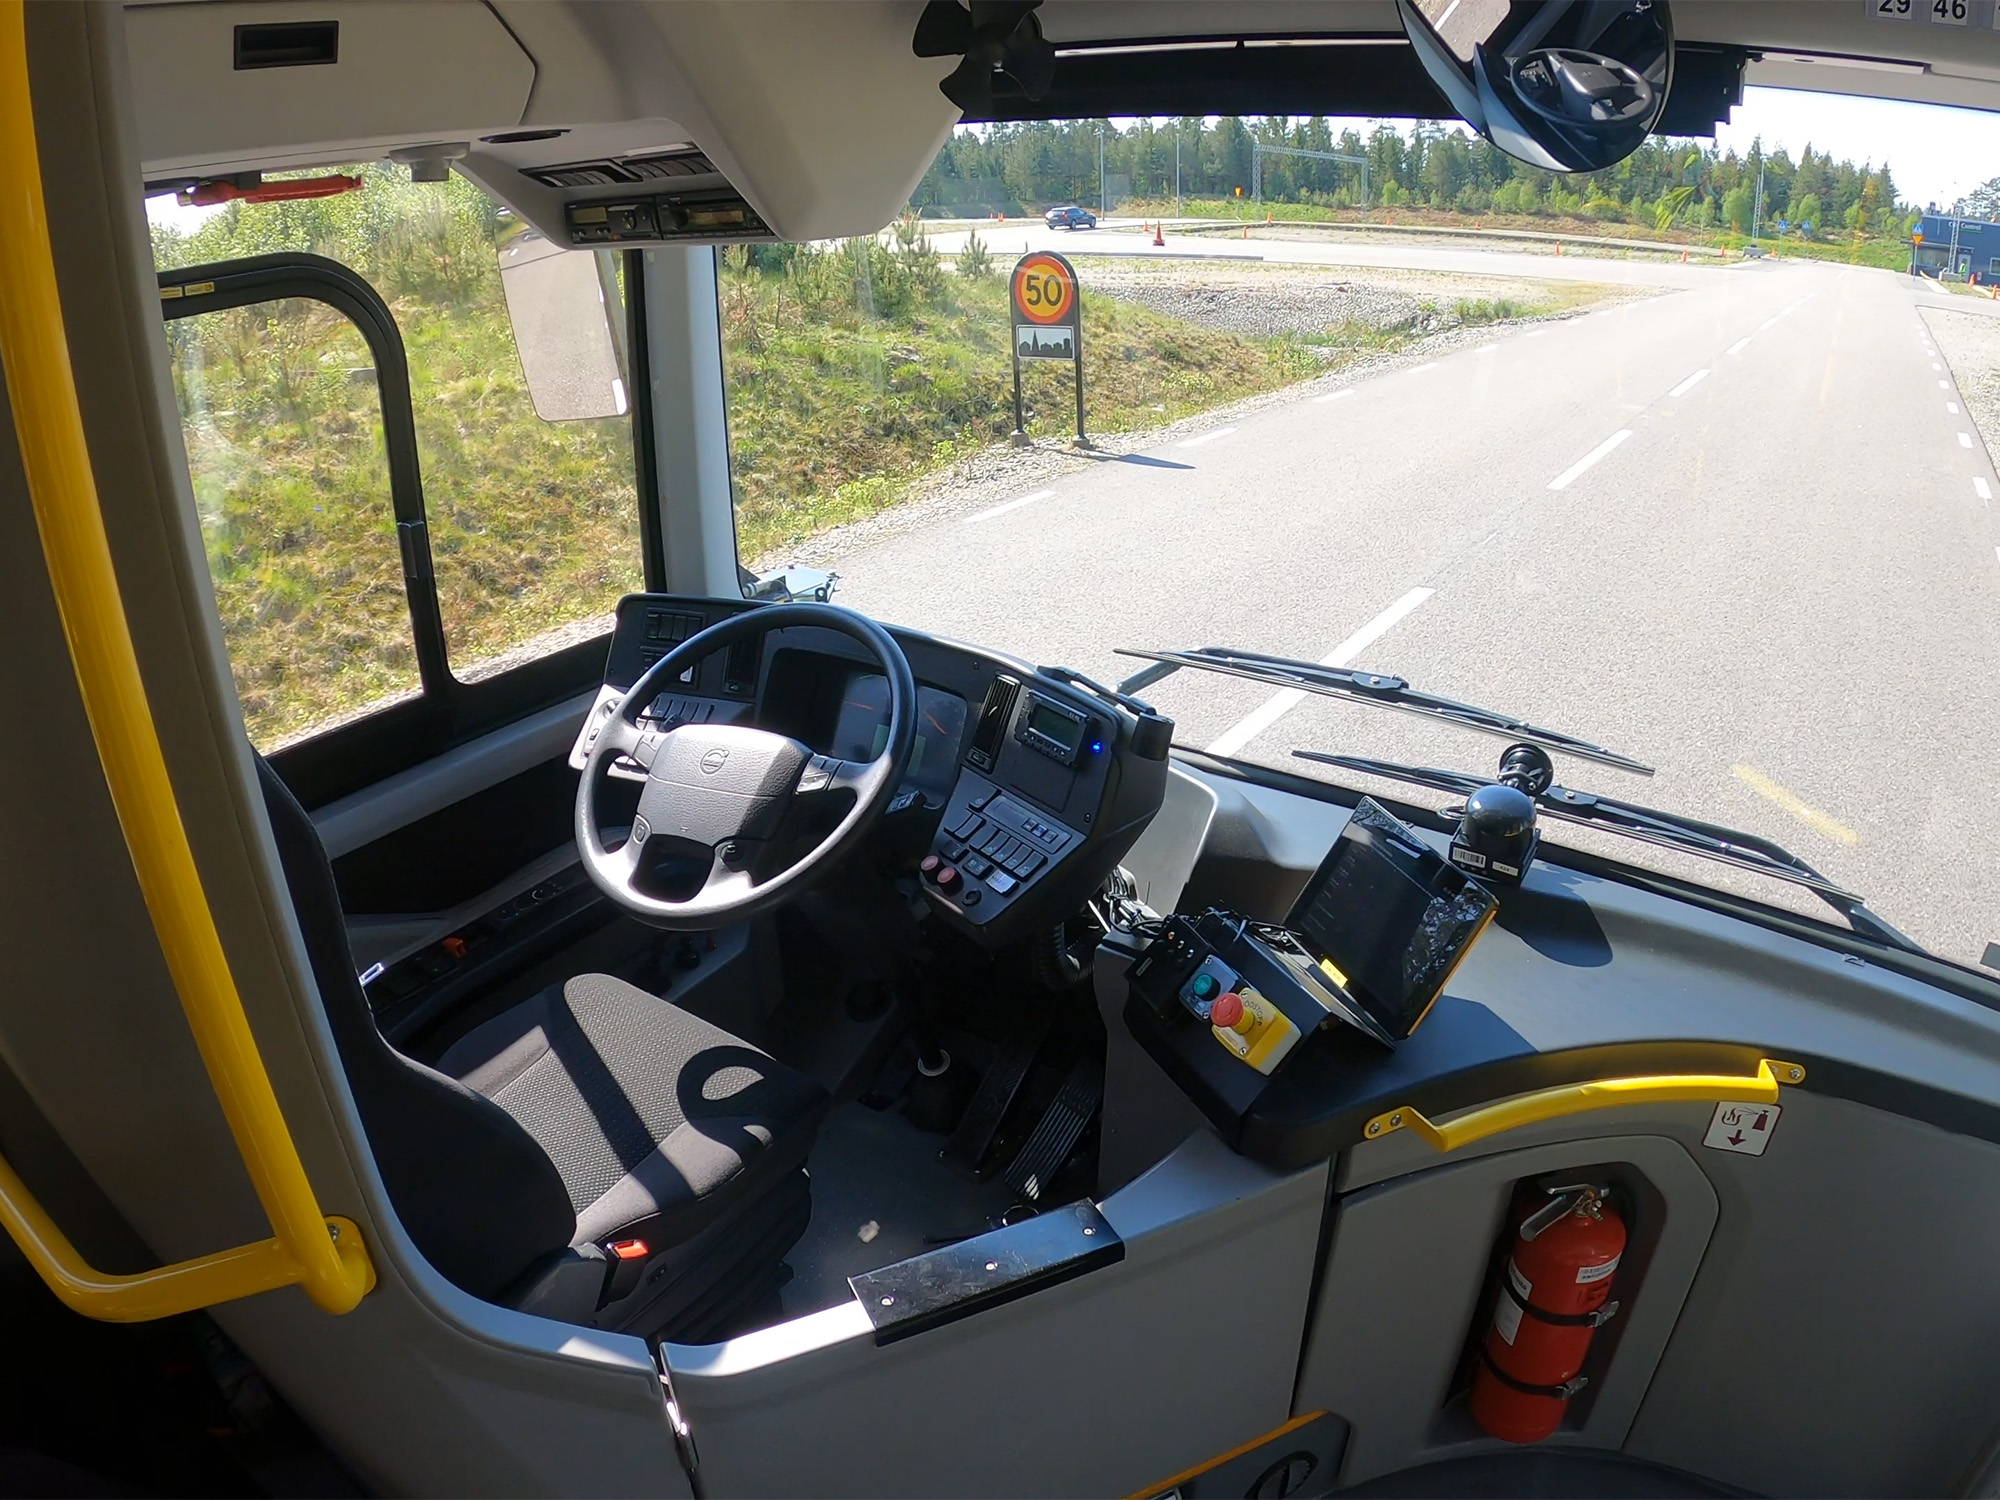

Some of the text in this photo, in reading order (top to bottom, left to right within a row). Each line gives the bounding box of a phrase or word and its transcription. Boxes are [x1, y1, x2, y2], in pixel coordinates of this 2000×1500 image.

[1879, 0, 1966, 19] 29 46
[1026, 275, 1062, 306] 50
